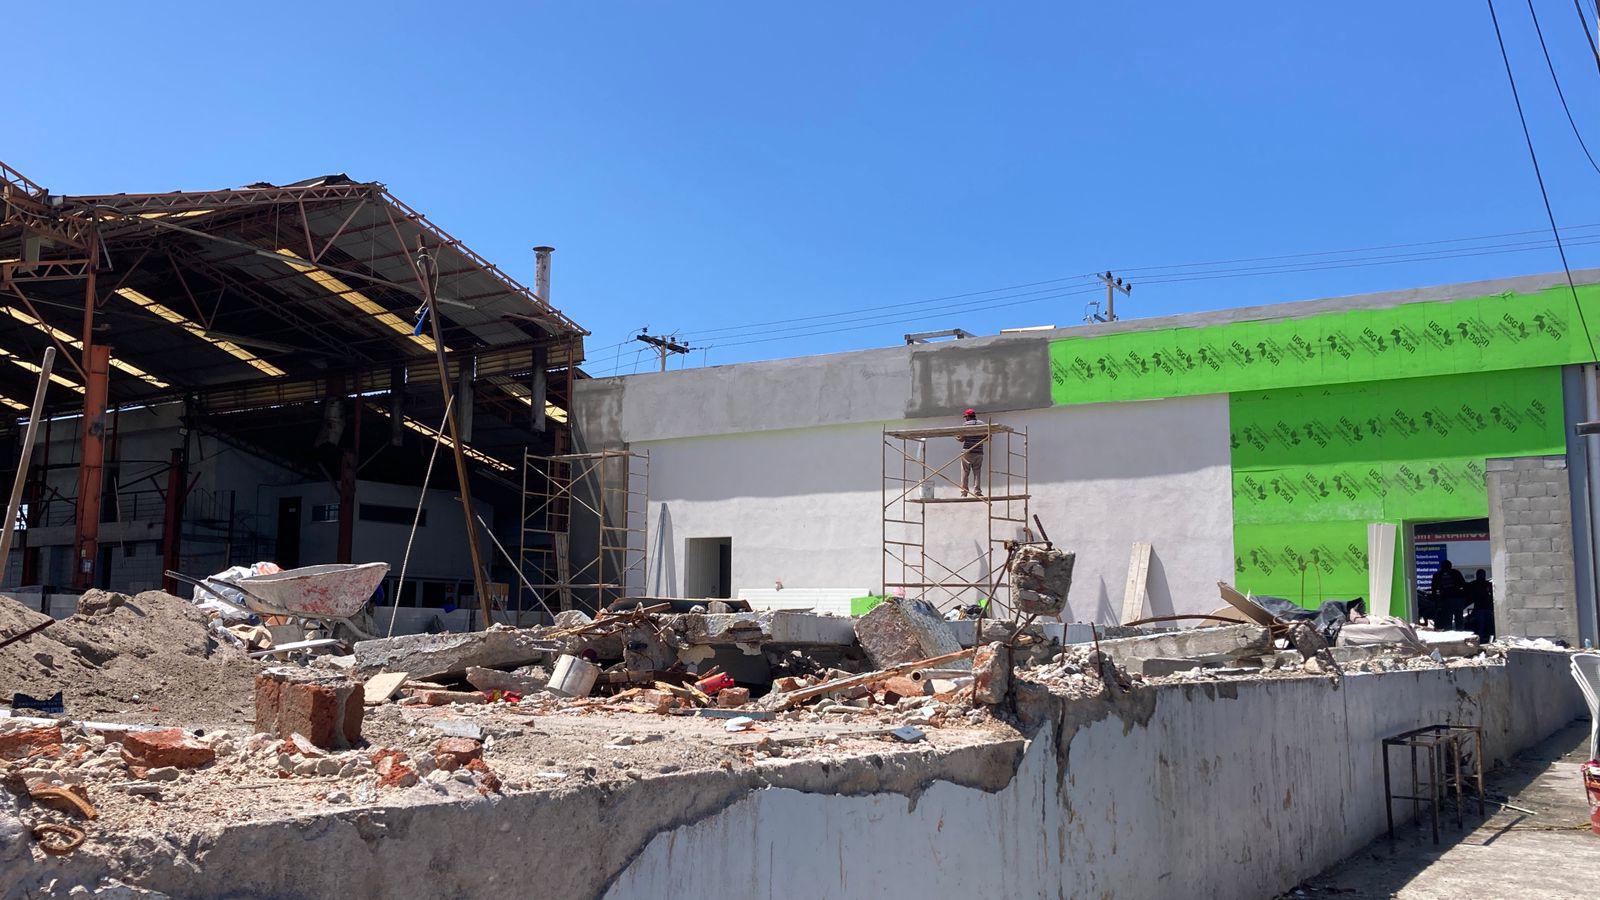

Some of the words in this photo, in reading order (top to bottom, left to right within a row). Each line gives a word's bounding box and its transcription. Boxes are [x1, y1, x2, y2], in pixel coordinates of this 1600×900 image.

[1428, 320, 1443, 336] USG
[1503, 313, 1519, 328] USG
[1291, 334, 1306, 348] USG
[1363, 327, 1377, 342] USG
[1231, 340, 1245, 354] USG
[1074, 356, 1087, 369] USG
[1128, 350, 1141, 364] USG
[1400, 465, 1414, 481] USG
[1467, 461, 1482, 477] USG
[1244, 475, 1258, 490] USG
[1305, 472, 1319, 487] USG
[1284, 545, 1298, 561] USG
[1348, 543, 1363, 559] USG
